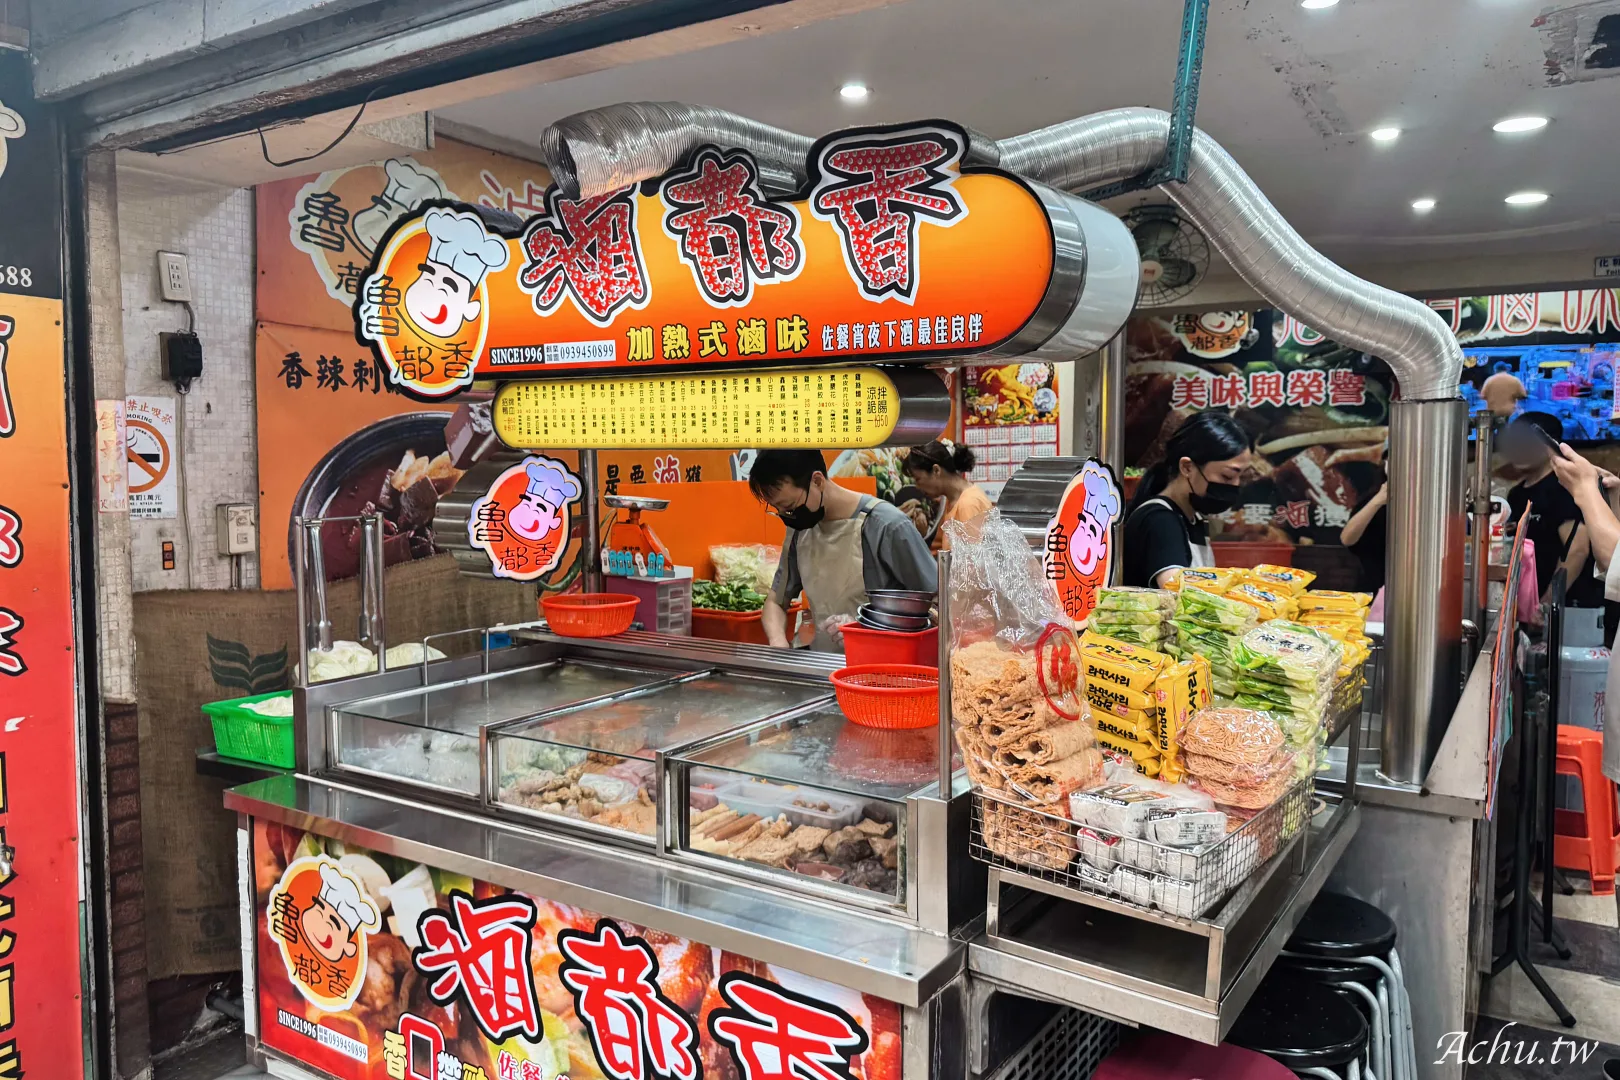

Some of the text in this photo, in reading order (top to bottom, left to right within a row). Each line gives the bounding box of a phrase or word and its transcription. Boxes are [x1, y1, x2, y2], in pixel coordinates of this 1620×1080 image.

[626, 315, 810, 362] 加熱式滷味
[821, 313, 984, 351] 佐餐宵夜下酒最佳良伴
[491, 346, 543, 365] SINCE1996
[560, 343, 614, 360] 0939450899
[277, 351, 400, 394] 香辣刺
[1173, 369, 1366, 410] 美味與榮譽
[126, 413, 153, 424] MOKING
[1088, 664, 1131, 687] 라면사리
[1088, 683, 1129, 706] 라면사리
[1097, 720, 1139, 741] 라면사리
[1158, 706, 1169, 750] 라면사리
[278, 1010, 317, 1038] SINCE1996
